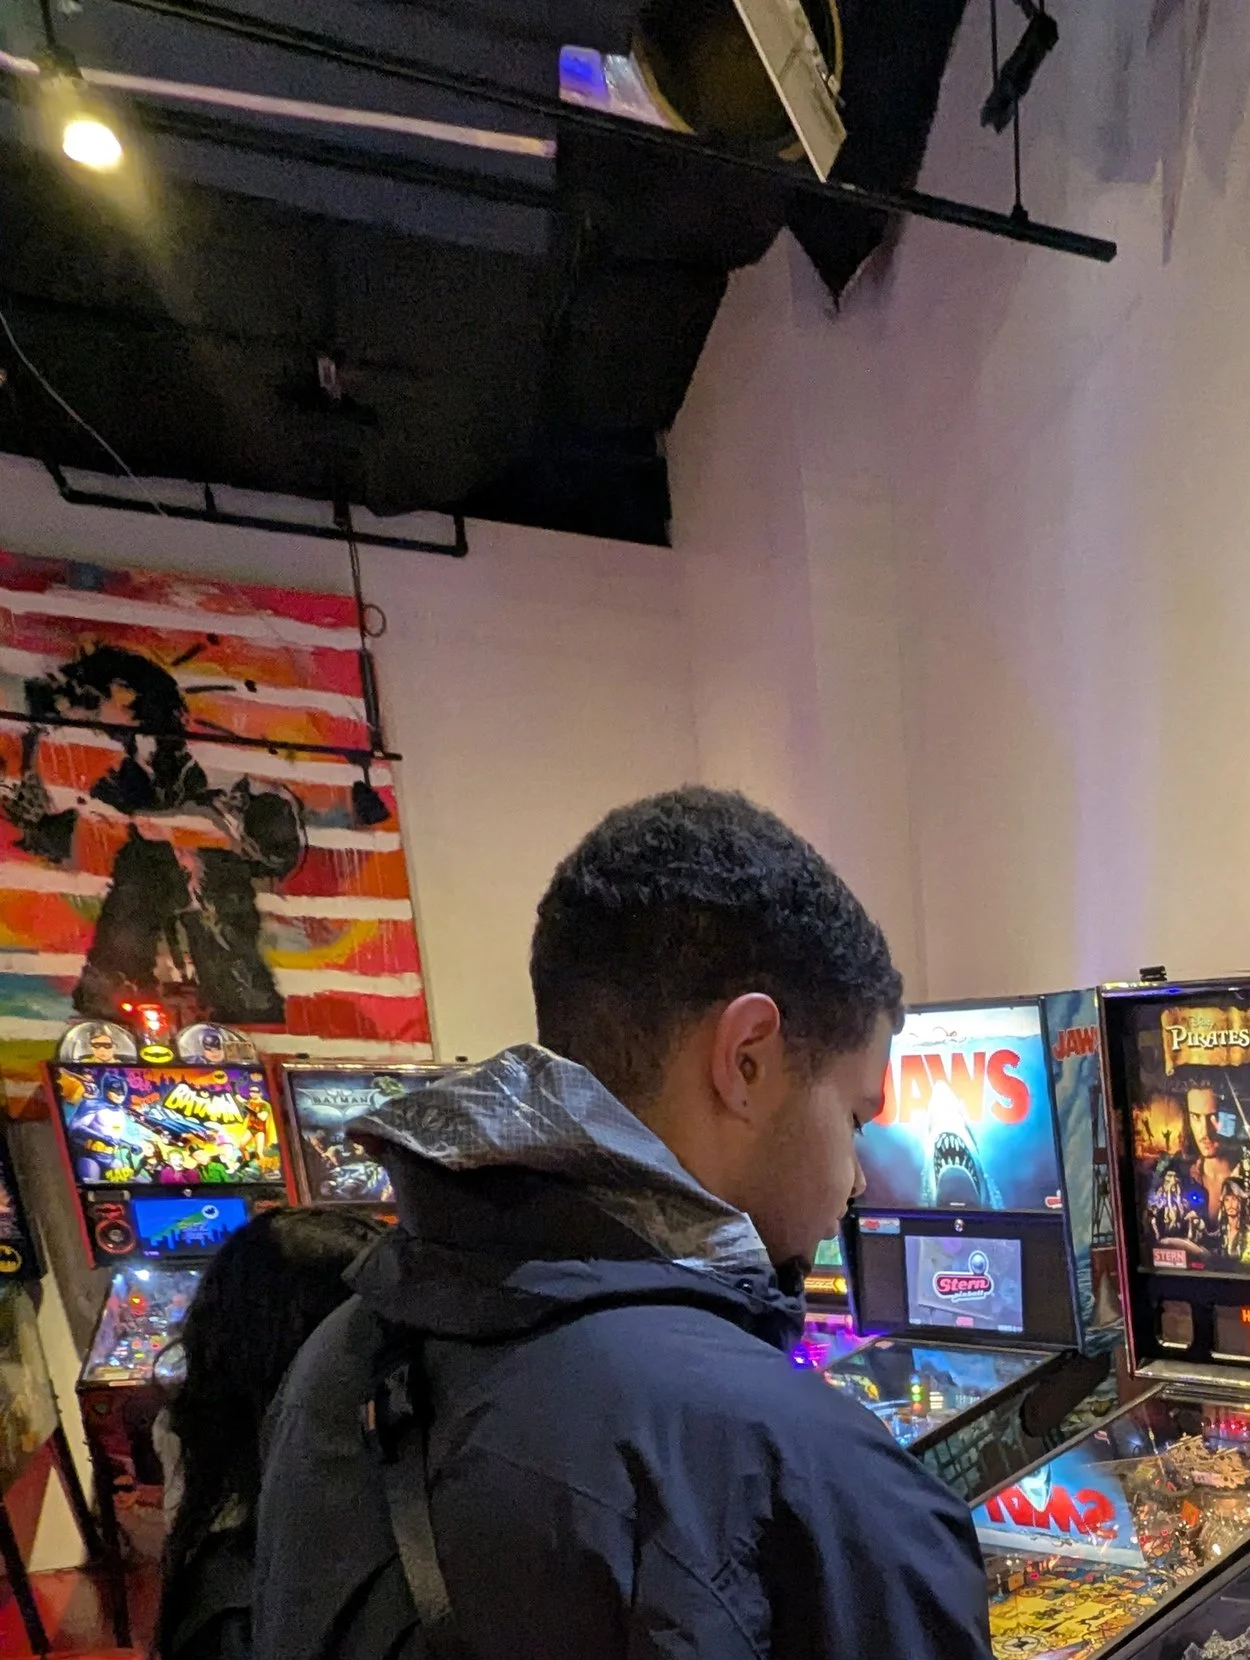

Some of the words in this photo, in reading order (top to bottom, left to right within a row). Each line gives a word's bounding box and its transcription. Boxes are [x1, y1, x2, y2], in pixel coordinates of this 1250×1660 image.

[1053, 1024, 1099, 1061] JAW
[1166, 1025, 1250, 1050] PIRATES
[164, 1084, 245, 1124] BATMAN
[313, 1096, 369, 1104] BATMAN
[938, 1276, 989, 1293] Stern
